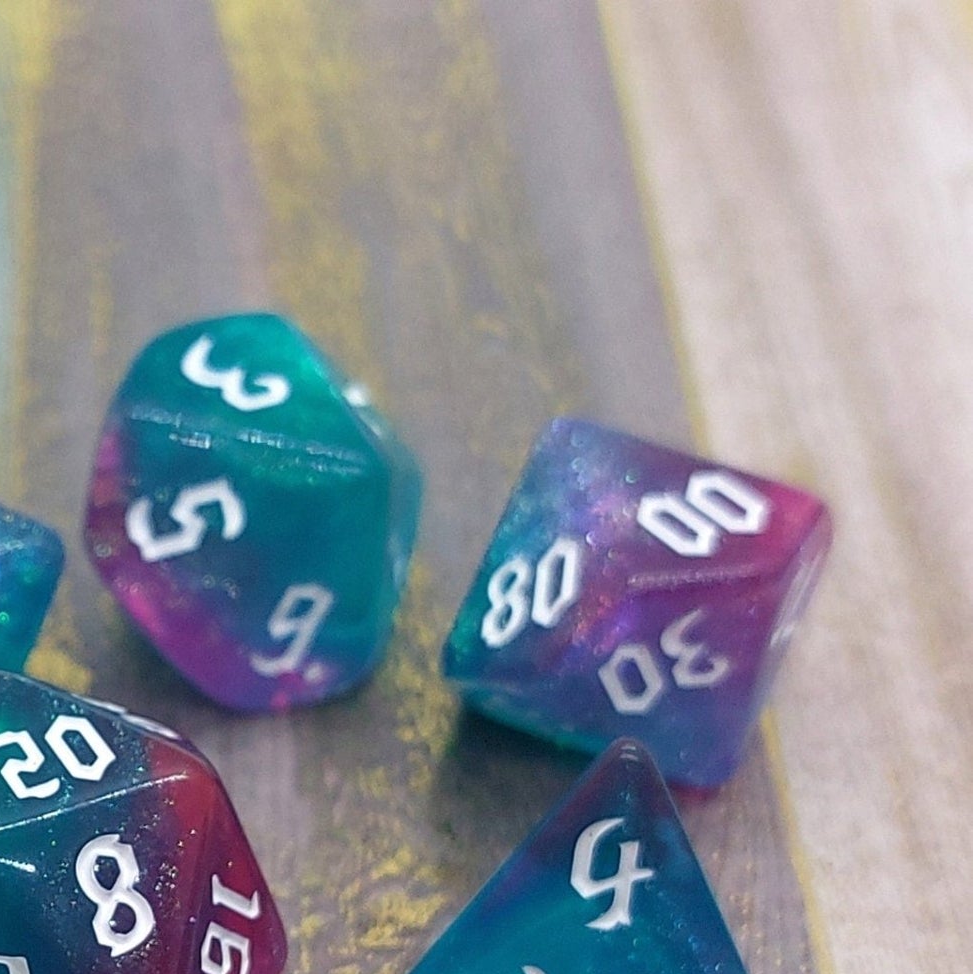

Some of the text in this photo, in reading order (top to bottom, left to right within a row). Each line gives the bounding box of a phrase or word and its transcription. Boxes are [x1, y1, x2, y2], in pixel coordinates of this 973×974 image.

[180, 333, 291, 412] 3
[126, 477, 246, 562] 5
[637, 469, 770, 556] 00
[480, 538, 582, 648] 80
[75, 833, 156, 957] 8
[570, 817, 654, 931] 4
